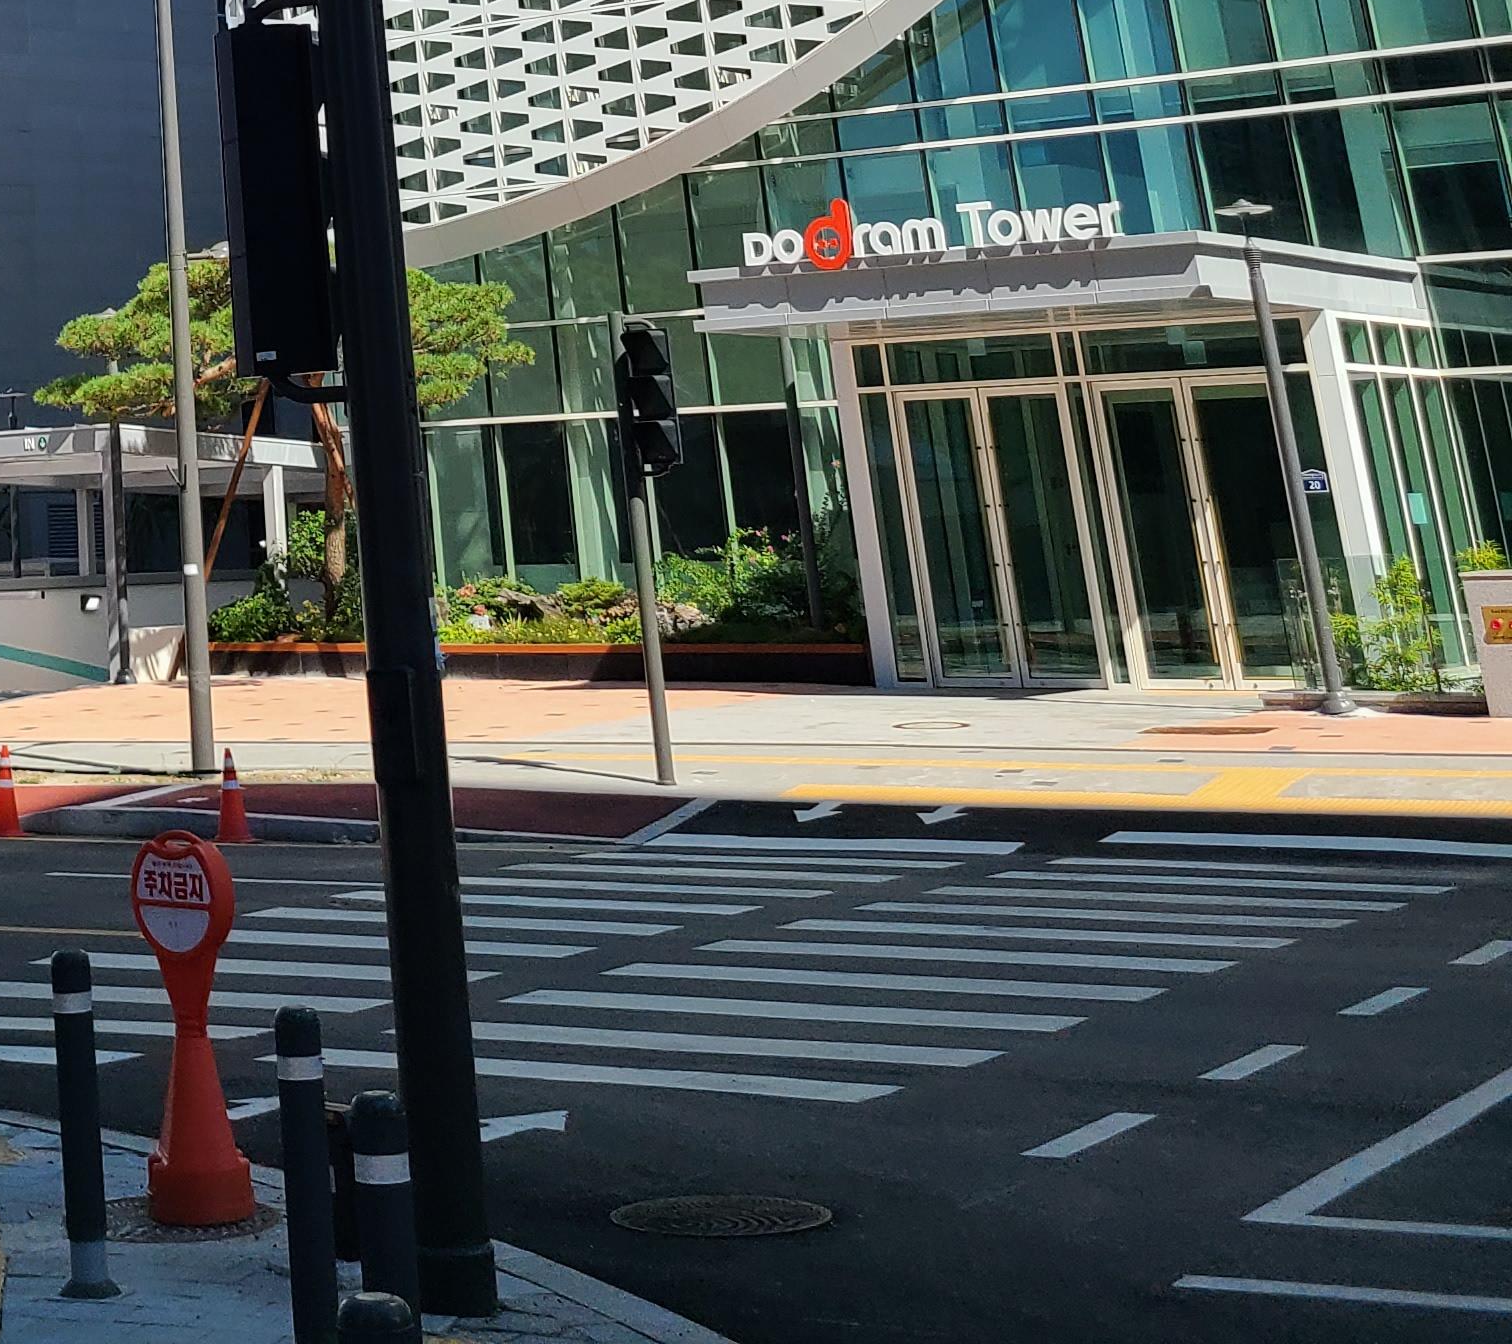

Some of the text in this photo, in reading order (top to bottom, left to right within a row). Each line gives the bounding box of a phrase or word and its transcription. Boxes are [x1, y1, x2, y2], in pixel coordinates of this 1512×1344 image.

[955, 201, 1124, 247] Tower
[24, 437, 36, 450] IN
[1308, 480, 1321, 490] 20
[143, 869, 204, 902] 주차금지
